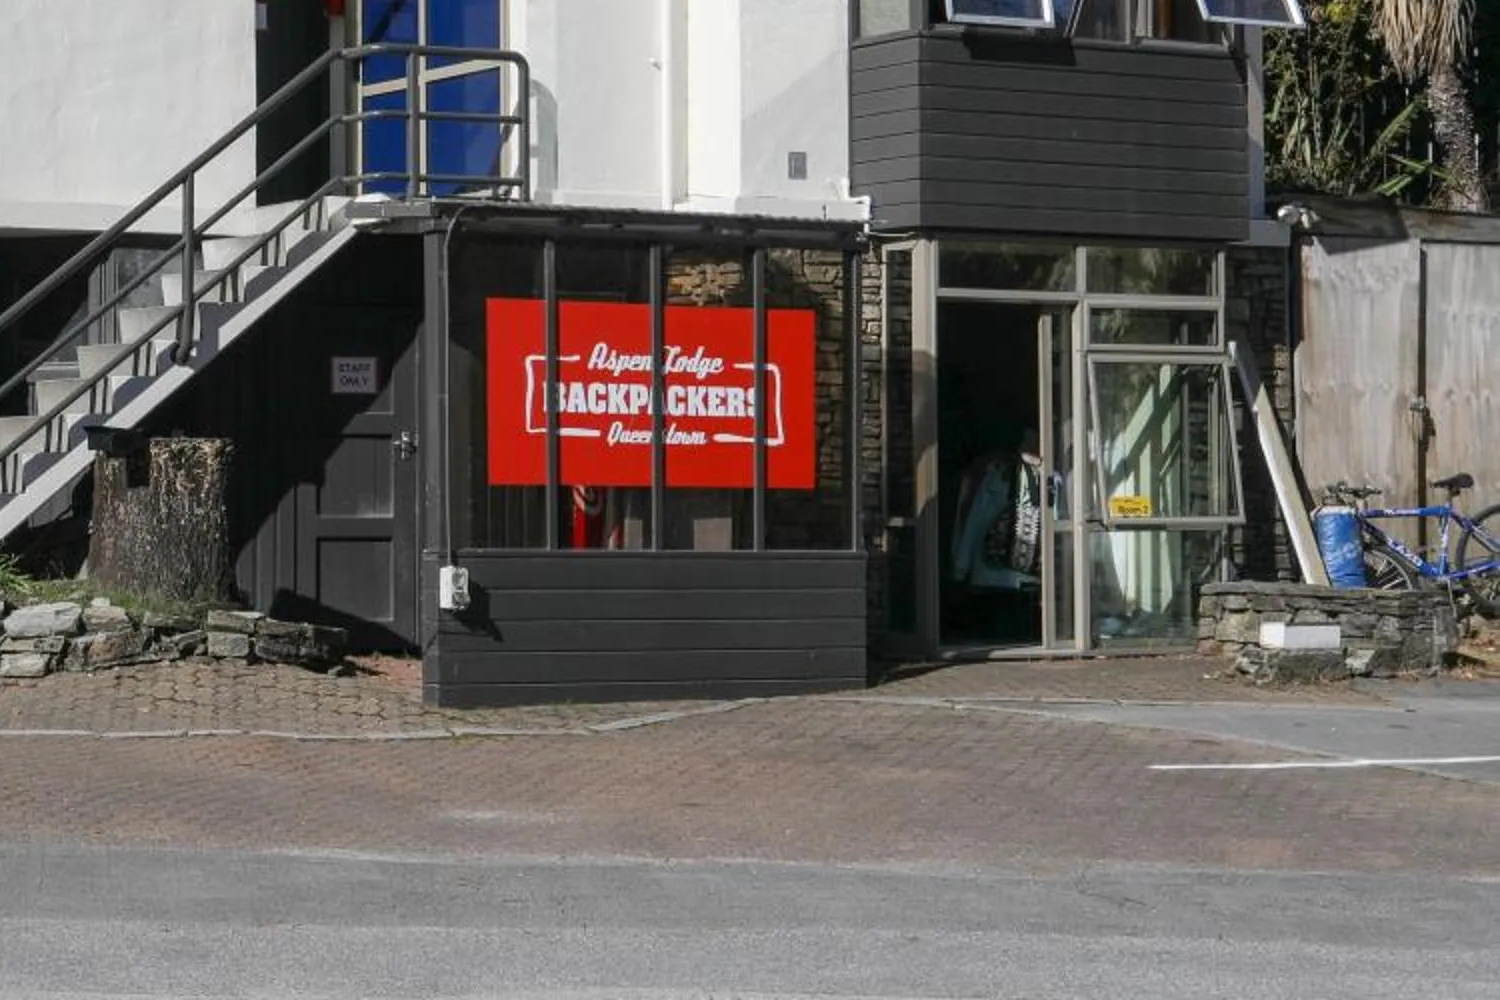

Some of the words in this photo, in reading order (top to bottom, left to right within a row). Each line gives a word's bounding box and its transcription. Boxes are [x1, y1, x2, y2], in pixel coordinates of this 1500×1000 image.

[588, 342, 654, 376] Aspen
[663, 345, 724, 379] Lodge
[340, 375, 368, 386] ONLY
[543, 381, 757, 417] BACKPCKERS
[607, 421, 707, 446] Queentown
